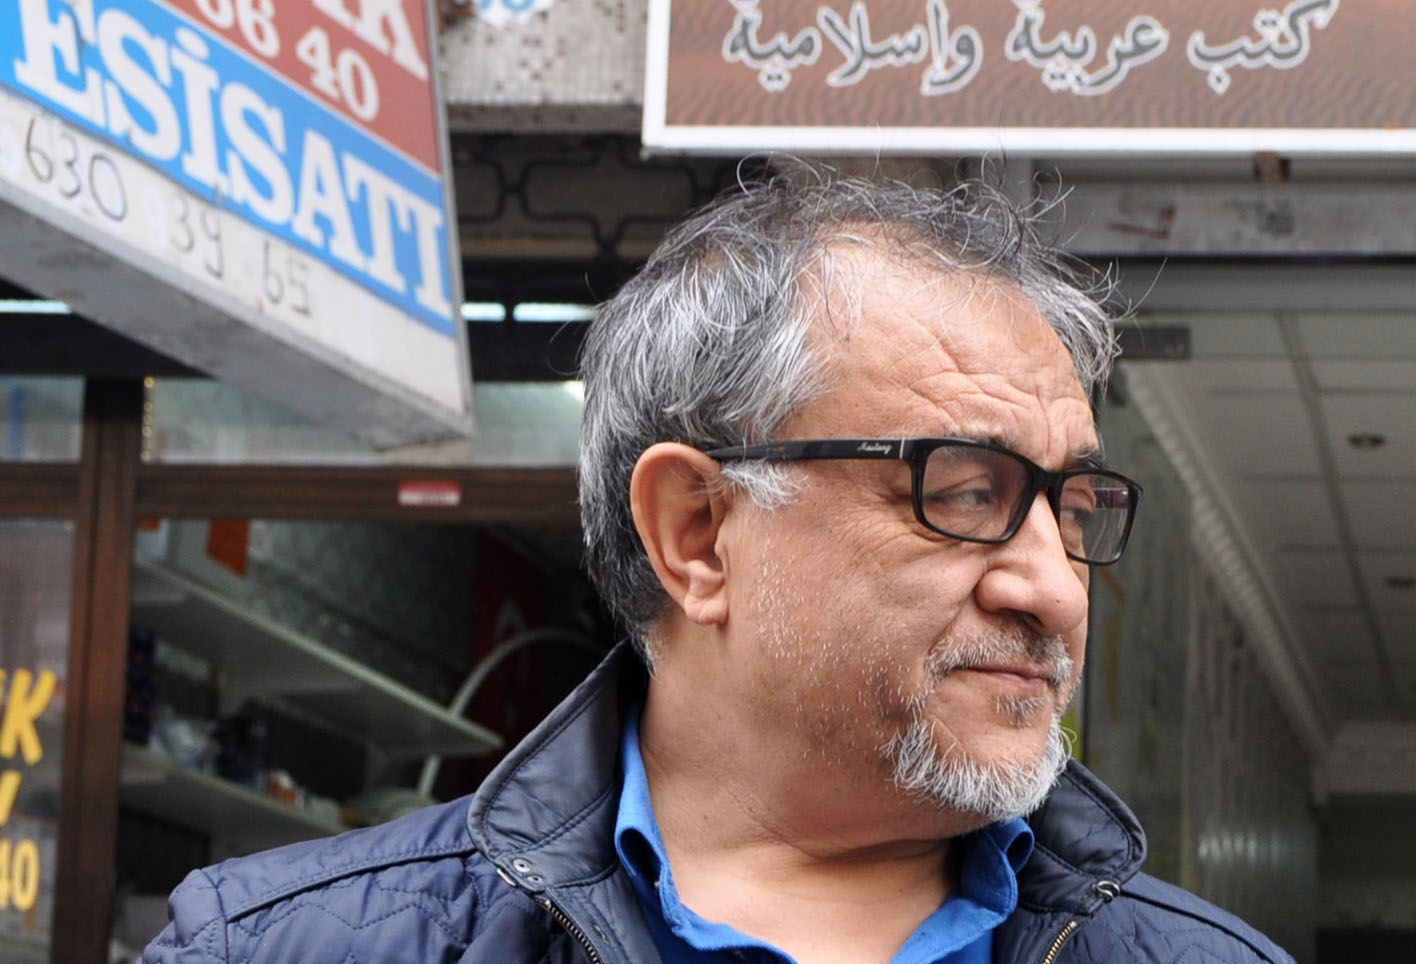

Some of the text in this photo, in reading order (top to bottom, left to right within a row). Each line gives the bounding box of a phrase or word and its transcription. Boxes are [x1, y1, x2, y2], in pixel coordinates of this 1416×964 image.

[296, 27, 380, 122] 40
[1187, 0, 1340, 94] كتب
[12, 0, 455, 322] ESİSATI
[25, 117, 128, 221] 630
[169, 190, 227, 279] 39
